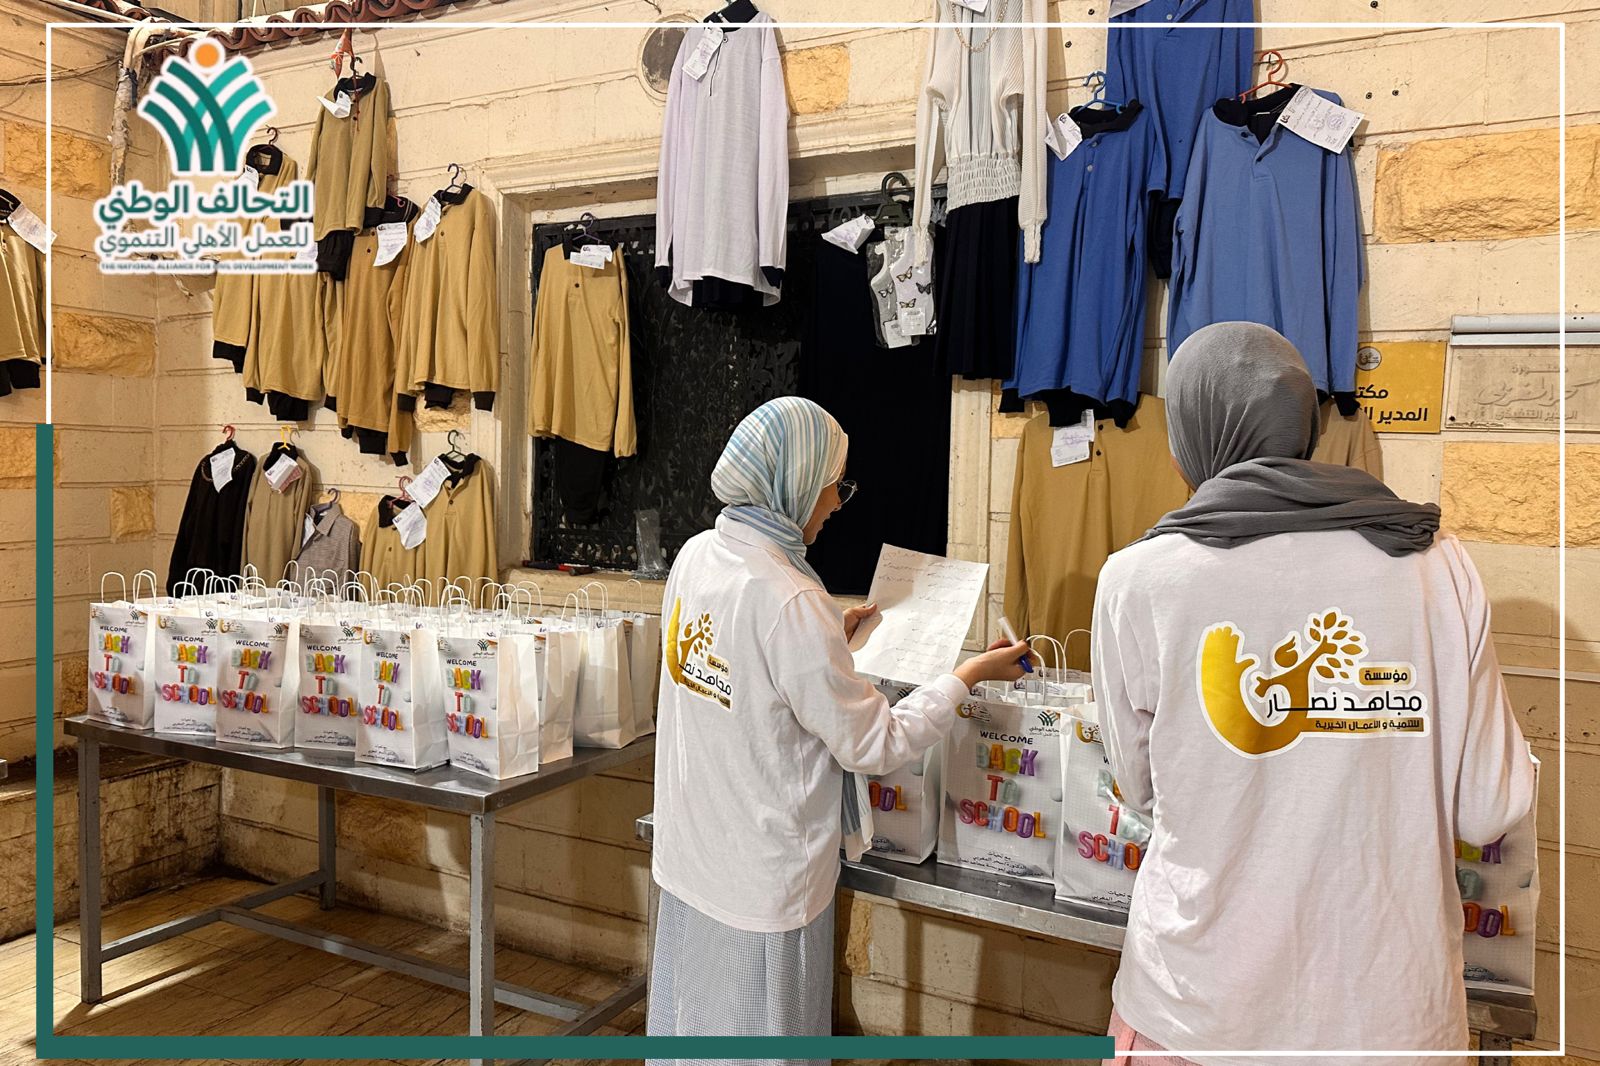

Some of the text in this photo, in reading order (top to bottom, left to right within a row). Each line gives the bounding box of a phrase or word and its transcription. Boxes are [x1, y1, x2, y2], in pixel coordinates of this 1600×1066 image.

[1355, 384, 1389, 399] مكت
[1376, 407, 1428, 424] المدير
[98, 633, 131, 654] BACK
[172, 635, 204, 643] WELCOME
[235, 639, 270, 648] WELCOME
[307, 644, 341, 652] WELCOME
[104, 653, 122, 673] TO
[170, 643, 209, 664] BACK
[231, 648, 272, 670] BACK
[305, 653, 346, 674] BACK
[375, 651, 399, 660] WELCOME
[446, 658, 477, 667] WELCOME
[177, 664, 200, 684] TO
[238, 670, 259, 691] TO
[374, 660, 400, 684] BACK
[446, 667, 482, 691] BACK
[695, 668, 732, 696] مجاهد
[1364, 669, 1408, 683] مؤسسة
[94, 671, 136, 695] SCHOOL
[315, 675, 338, 695] TO
[161, 683, 217, 705] SCHOOL
[221, 689, 269, 714] SCHOOL
[378, 684, 392, 705] TO
[454, 691, 475, 713] TO
[1266, 690, 1422, 718] مجاهد نصار
[301, 695, 358, 718] SCHOOL
[362, 705, 404, 731] SCHOOL
[446, 712, 489, 739] SCHOOL
[1315, 719, 1420, 731] للتنمية و الأعمال الخيرية
[980, 730, 1034, 745] WELCOME
[975, 742, 1039, 776] BACK
[868, 781, 908, 812] OOL
[986, 774, 1022, 804] TO
[959, 798, 1046, 839] SCHOOL
[1077, 830, 1147, 871] SCHO
[1463, 902, 1517, 938] OOL
